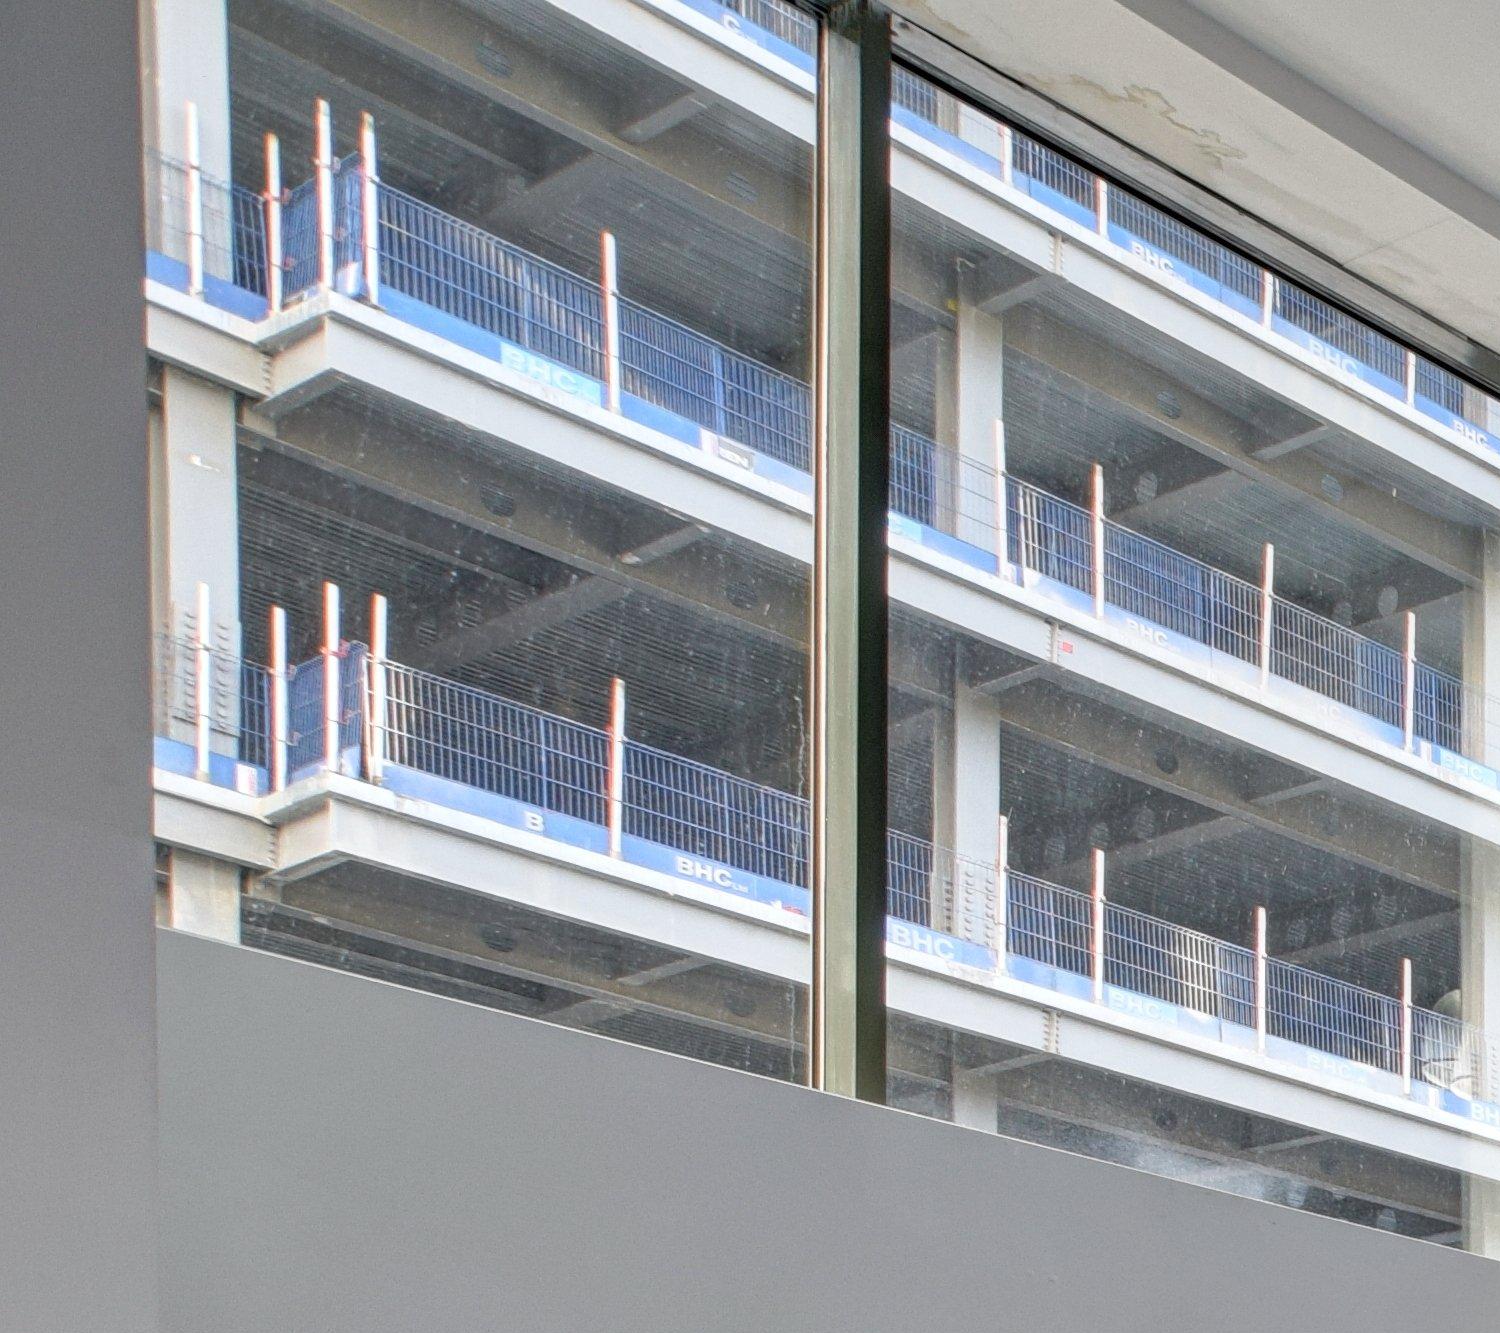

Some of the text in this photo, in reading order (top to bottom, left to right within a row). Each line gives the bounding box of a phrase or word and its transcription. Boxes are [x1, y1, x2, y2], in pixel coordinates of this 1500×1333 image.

[1132, 241, 1175, 276] BHC
[503, 350, 578, 394] BHC
[1308, 340, 1358, 376] BHC
[677, 856, 733, 887] BHC
[891, 924, 955, 960] BHC
